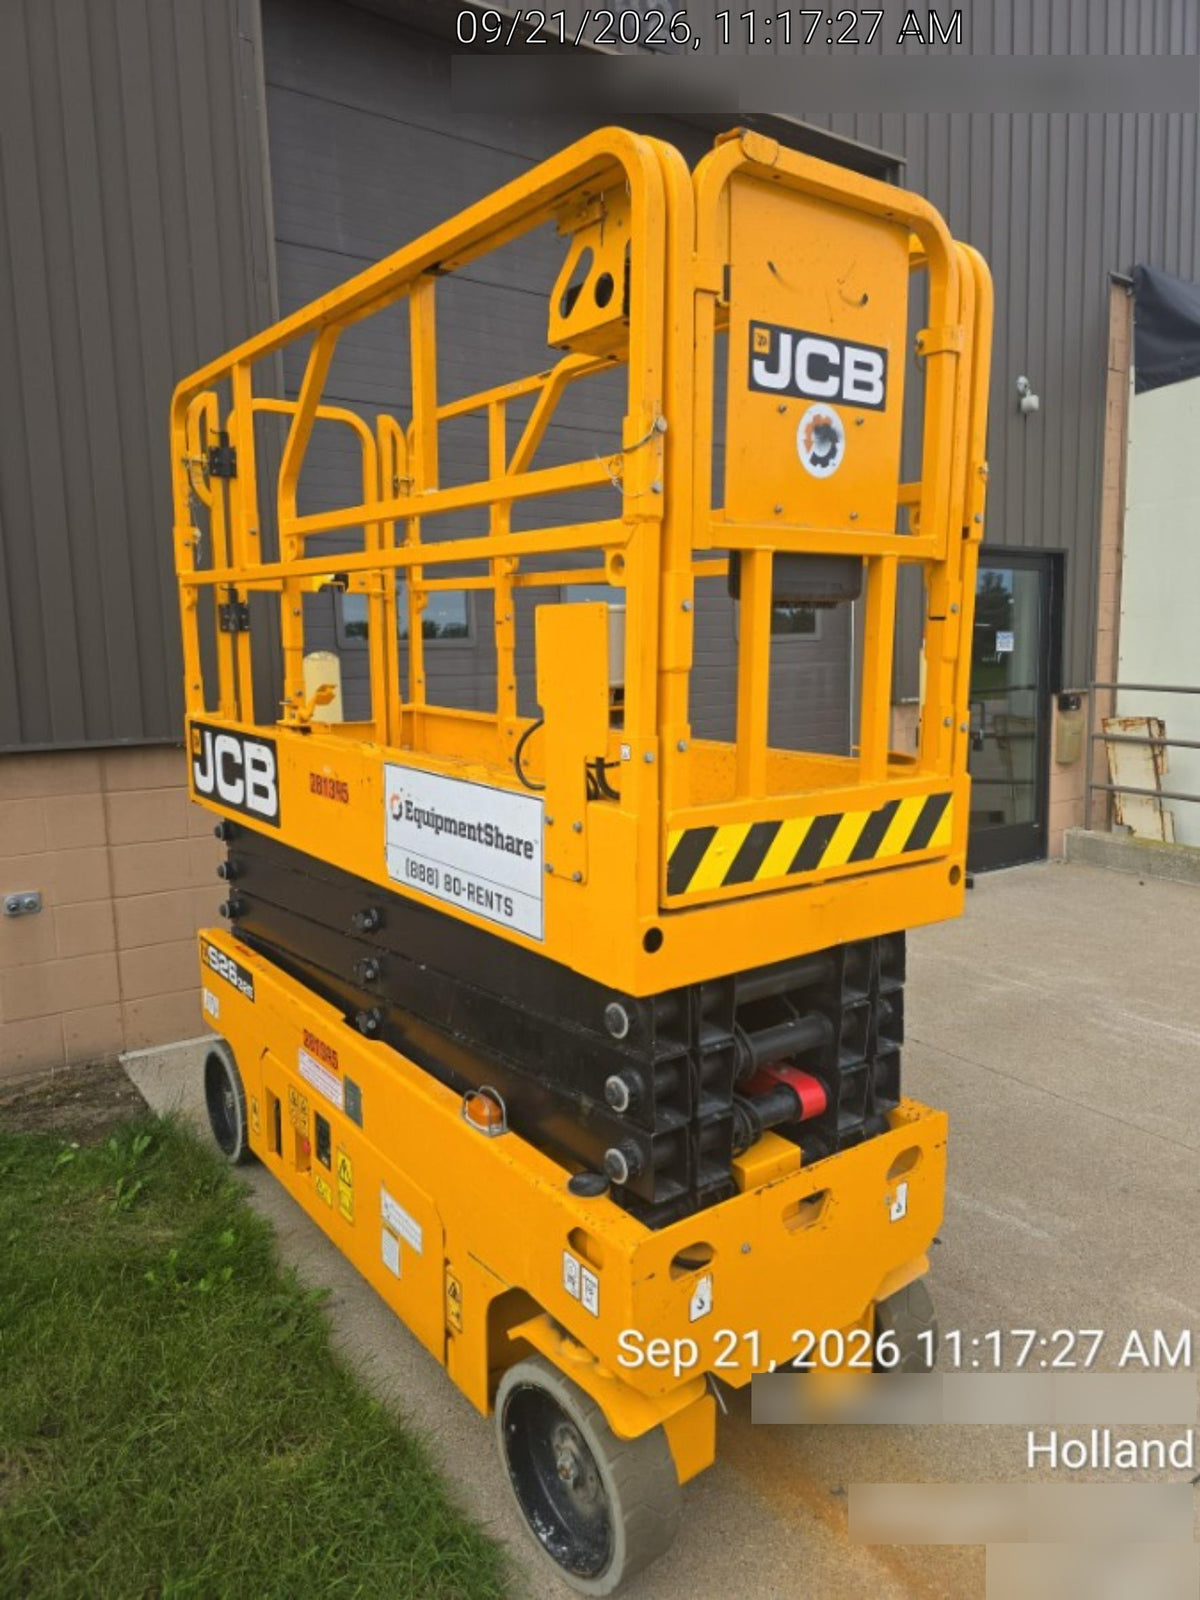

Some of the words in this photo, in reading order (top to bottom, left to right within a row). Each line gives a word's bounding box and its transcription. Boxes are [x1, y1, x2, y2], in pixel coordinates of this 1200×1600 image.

[753, 332, 884, 405] JCB
[193, 731, 278, 817] JCB
[404, 799, 535, 860] EquipmentShare
[405, 856, 439, 890] (888)
[443, 872, 514, 917] 80-RENTS
